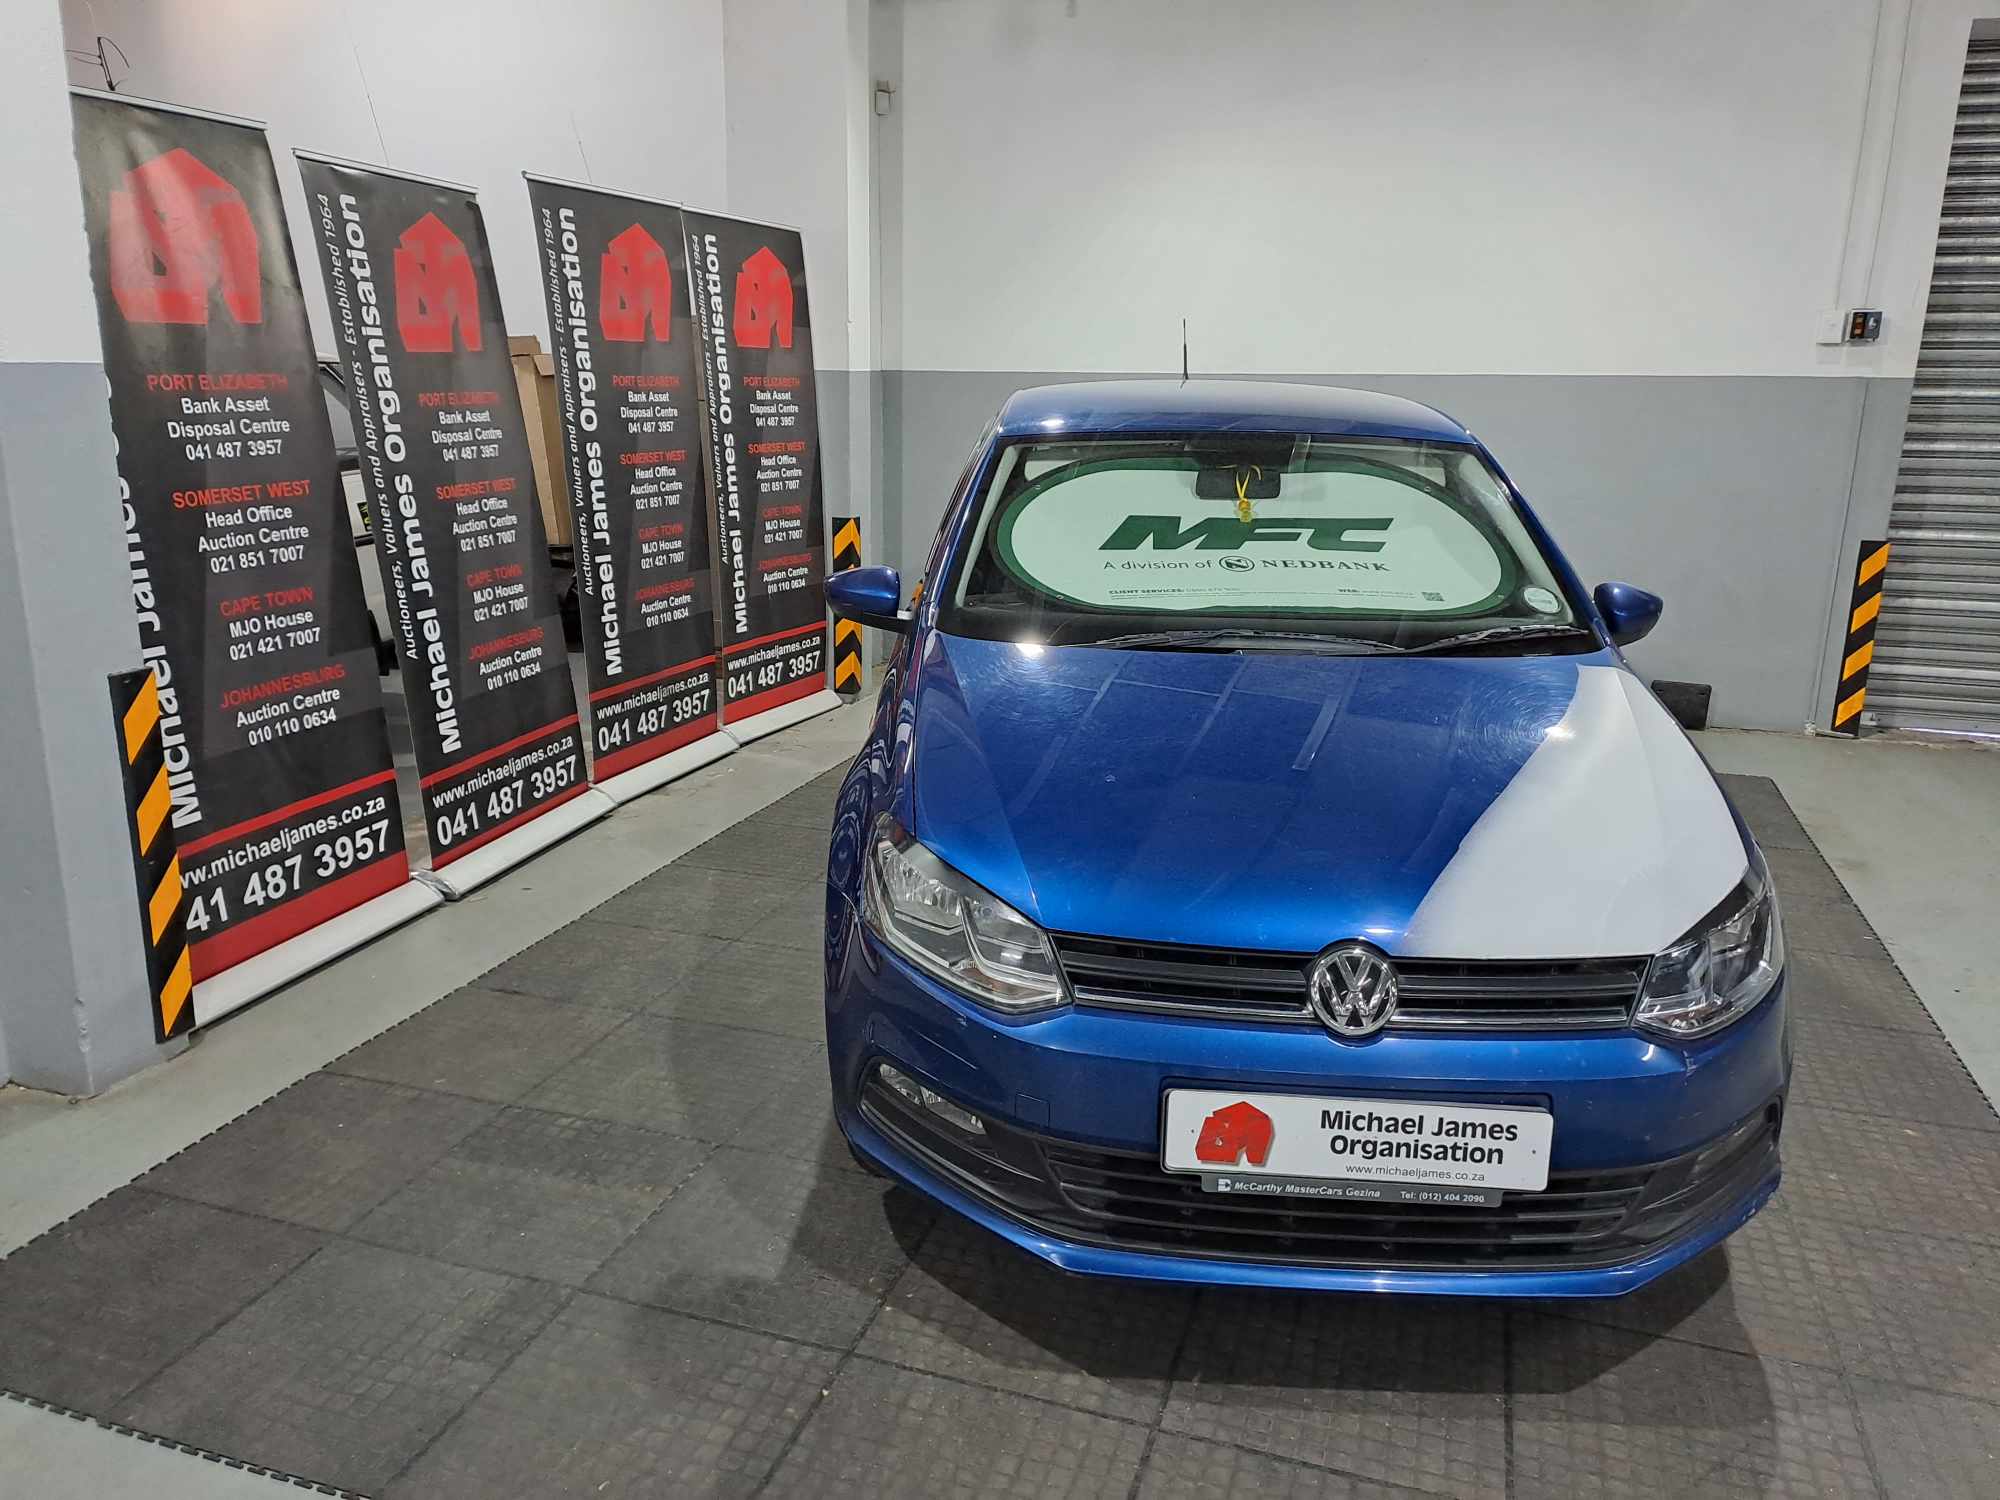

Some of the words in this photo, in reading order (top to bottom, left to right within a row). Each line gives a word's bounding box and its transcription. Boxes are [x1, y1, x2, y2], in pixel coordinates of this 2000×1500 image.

[316, 192, 336, 239] 1964
[542, 207, 555, 245] 1964
[691, 234, 700, 269] 1964
[326, 242, 357, 345] Established
[547, 246, 565, 334] Established
[697, 270, 709, 341] Established
[339, 194, 406, 463] Organisation
[558, 207, 598, 432] Organisation
[704, 234, 732, 424] Organisation
[147, 374, 194, 391] PORT
[558, 345, 578, 422] Appraisers
[628, 391, 647, 402] Bank
[649, 391, 669, 402] Asset
[181, 398, 220, 414] Bank
[225, 397, 270, 413] Asset
[350, 359, 378, 452] Appraisers
[439, 411, 463, 425] Bank
[465, 410, 491, 423] Asset
[620, 407, 653, 420] Disposal
[655, 406, 678, 417] Centre
[167, 420, 235, 440] Disposal
[240, 419, 290, 434] Centre
[432, 430, 473, 446] Disposal
[475, 429, 503, 443] Centre
[566, 424, 578, 452] and
[628, 423, 640, 434] 041
[642, 422, 655, 433] 487
[658, 421, 674, 432] 3957
[186, 444, 211, 461] 041
[216, 442, 242, 459] 487
[248, 440, 282, 457] 3957
[443, 448, 458, 462] 041
[461, 446, 477, 460] 487
[480, 445, 499, 458] 3957
[367, 454, 384, 488] and
[570, 455, 585, 507] Valuers
[655, 466, 676, 477] Office
[724, 433, 739, 521] James
[172, 483, 262, 509] SOMERSET
[267, 480, 311, 497] WEST
[435, 480, 490, 500] SOMERSET
[586, 441, 610, 545] James
[630, 483, 658, 496] Auction
[659, 480, 683, 492] Centre
[635, 498, 648, 510] 021
[205, 510, 242, 529] Head
[247, 505, 293, 522] Office
[377, 491, 397, 555] Valuers
[456, 502, 480, 516] Head
[481, 498, 508, 512] Office
[198, 530, 255, 553] Auction
[259, 525, 310, 544] Centre
[394, 473, 434, 598] James
[452, 516, 488, 535] Auction
[490, 513, 518, 528] Centre
[1098, 514, 1394, 552] MFC
[461, 537, 476, 552] 021
[478, 534, 495, 549] 851
[498, 530, 516, 546] 7007
[576, 512, 594, 596] Auctioneers,
[659, 539, 682, 551] House
[210, 555, 235, 574] 021
[239, 551, 265, 569] 851
[270, 545, 305, 564] 7007
[641, 557, 653, 569] 021
[655, 555, 667, 567] 421
[669, 551, 685, 563] 7007
[1103, 560, 1116, 570] A
[1121, 559, 1189, 570] division
[1195, 559, 1212, 569] of
[1262, 559, 1391, 572] NEDBANK
[473, 587, 493, 605] MJO
[495, 582, 525, 599] House
[729, 530, 748, 633] Michael
[220, 595, 261, 618] CAPE
[267, 586, 315, 607] TOWN
[391, 560, 418, 660] Auctioneers,
[474, 607, 490, 622] 021
[491, 602, 508, 618] 421
[510, 596, 529, 613] 7007
[595, 554, 623, 676] Michael
[640, 599, 668, 615] Auction
[669, 593, 692, 607] Centre
[229, 618, 262, 639] MJO
[265, 610, 314, 630] House
[229, 642, 254, 661] 021
[257, 636, 283, 653] 421
[287, 627, 321, 647] 7007
[728, 636, 820, 671] www.michaeljames.co.za
[479, 656, 513, 676] Auction
[514, 645, 543, 665] Centre
[487, 675, 503, 691] 010
[505, 669, 519, 686] 110
[521, 661, 541, 681] 0634
[728, 671, 754, 698] 041
[758, 662, 783, 687] 487
[789, 651, 820, 678] 3957
[220, 664, 346, 710] JOHANNESBURG
[416, 607, 462, 754] Michael
[596, 672, 710, 721] www.michaeljames.co.za
[236, 700, 290, 728] Auction
[293, 688, 341, 711] Centre
[598, 718, 631, 752] 041
[637, 704, 668, 736] 487
[672, 688, 710, 723] 3957
[248, 727, 272, 746] 010
[275, 718, 300, 739] 110
[303, 707, 337, 730] 0634
[432, 734, 574, 809] www.michaeljames.co.za
[436, 801, 481, 847] 041
[487, 780, 524, 821] 487
[530, 755, 577, 800] 3957
[186, 887, 228, 932] 41
[243, 855, 302, 907] 487
[314, 819, 389, 878] 3957
[1320, 1110, 1425, 1135] Michael
[1431, 1116, 1518, 1142] James
[1330, 1135, 1504, 1165] Organisation
[1346, 1164, 1485, 1182] www.michaeljames.co.za
[1234, 1182, 1283, 1194] McCarthy
[1285, 1185, 1343, 1196] MasterCars
[1346, 1187, 1381, 1198] Gezina
[1400, 1191, 1416, 1200] Tel:
[1419, 1191, 1442, 1201] (012)
[1444, 1193, 1461, 1201] 404
[1463, 1194, 1485, 1202] 2090
